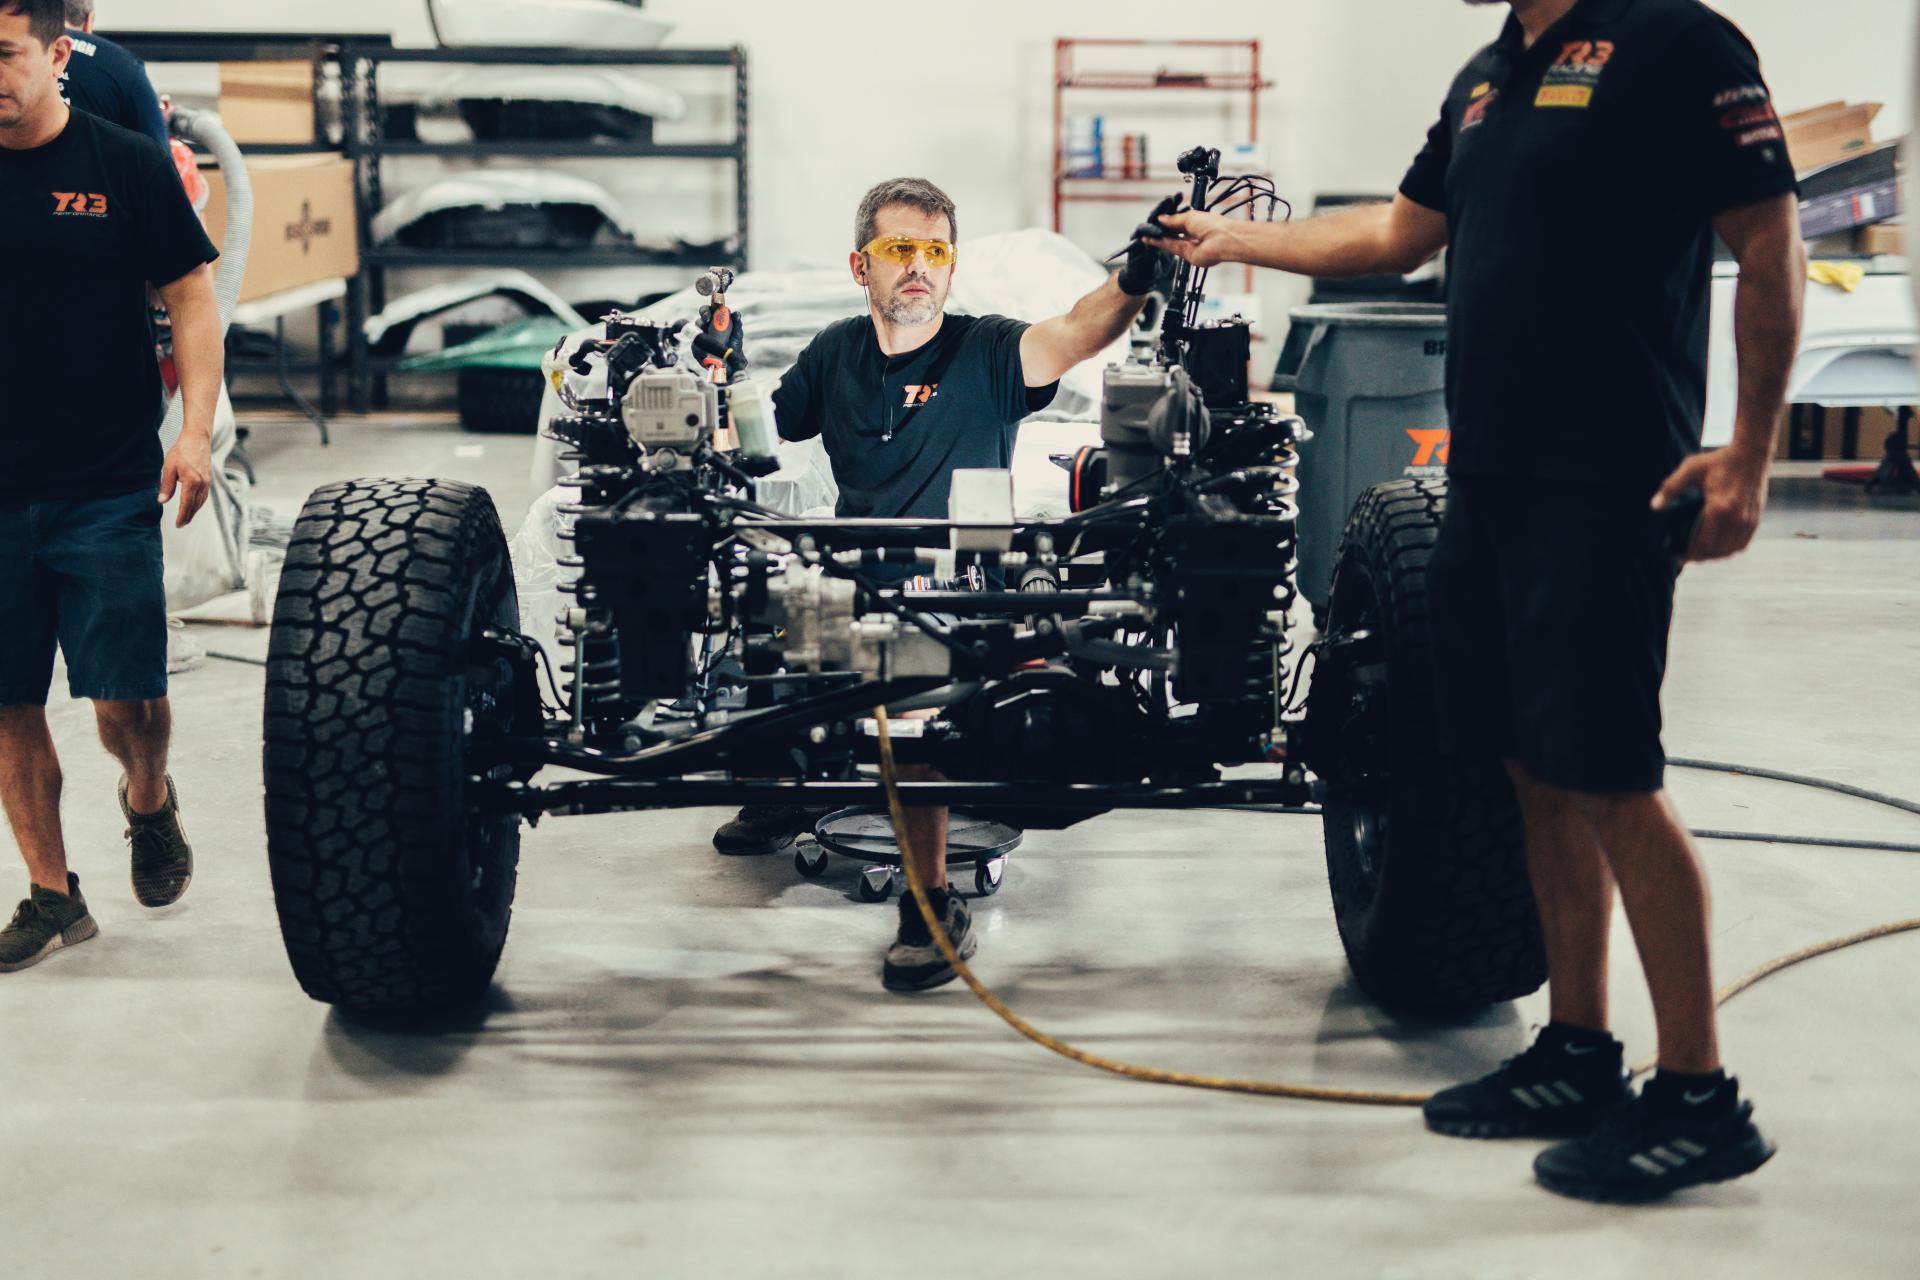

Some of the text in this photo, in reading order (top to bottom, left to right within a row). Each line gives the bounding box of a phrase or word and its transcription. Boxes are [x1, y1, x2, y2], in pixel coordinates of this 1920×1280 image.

[51, 191, 107, 213] TR3
[903, 384, 938, 404] TR
[1406, 428, 1452, 465] TR
[1403, 465, 1448, 477] PERFO
